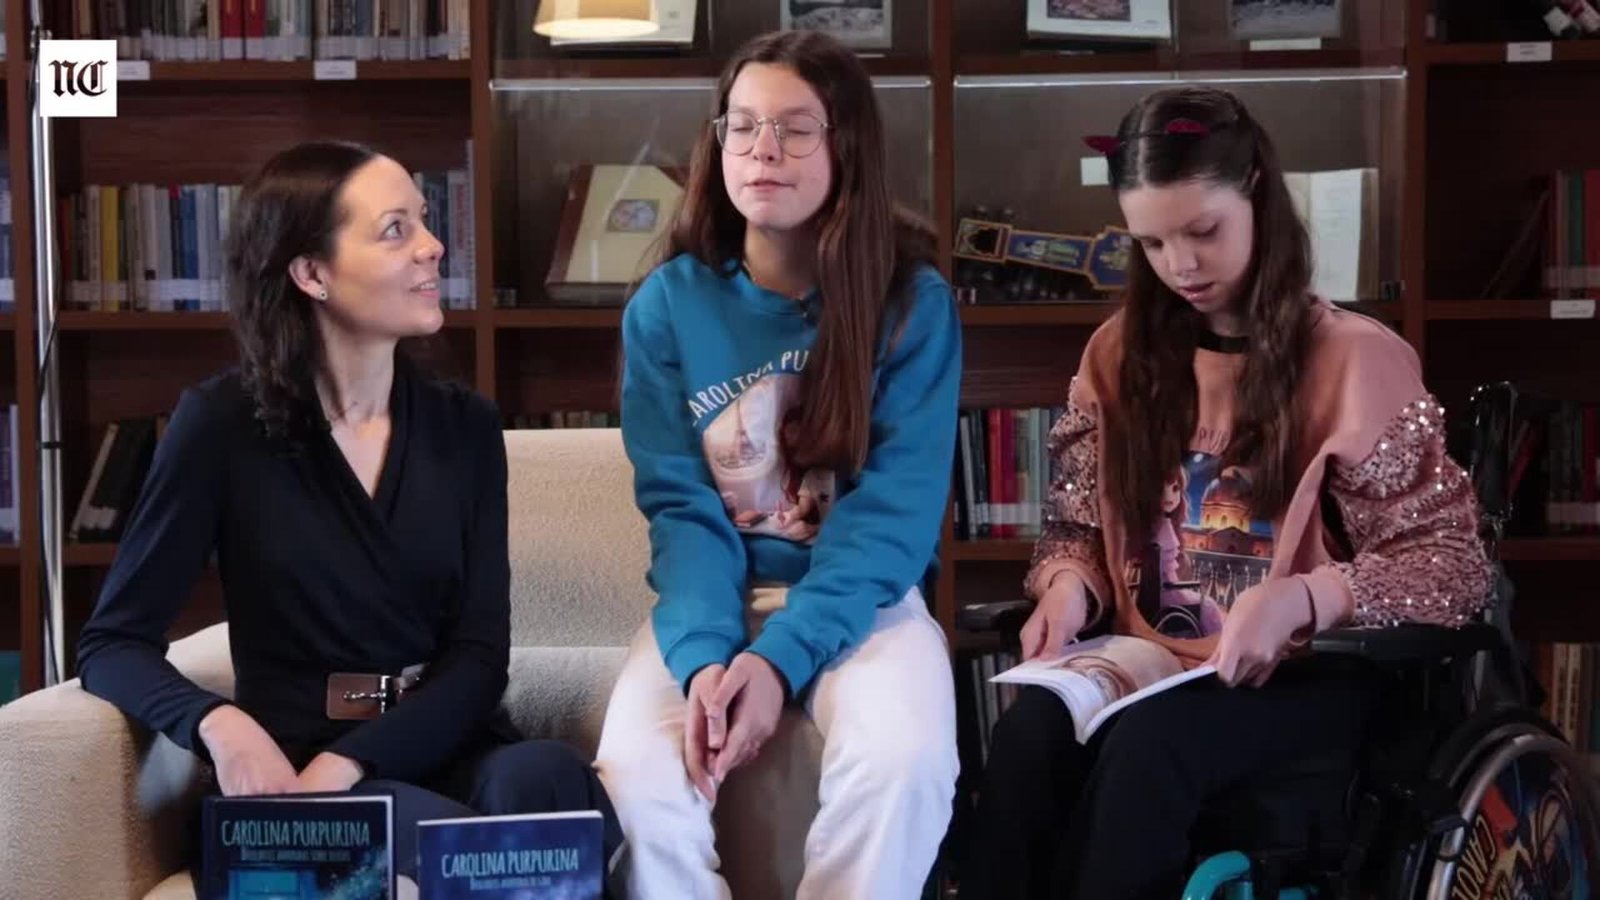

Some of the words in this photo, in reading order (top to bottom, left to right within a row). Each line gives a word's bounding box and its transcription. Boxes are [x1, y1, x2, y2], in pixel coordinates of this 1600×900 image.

[688, 361, 774, 427] AROLINA
[221, 820, 290, 846] CAROLINA
[292, 820, 370, 846] PURPURINA
[441, 851, 505, 878] CAROLINA
[507, 848, 579, 874] PURPURINA
